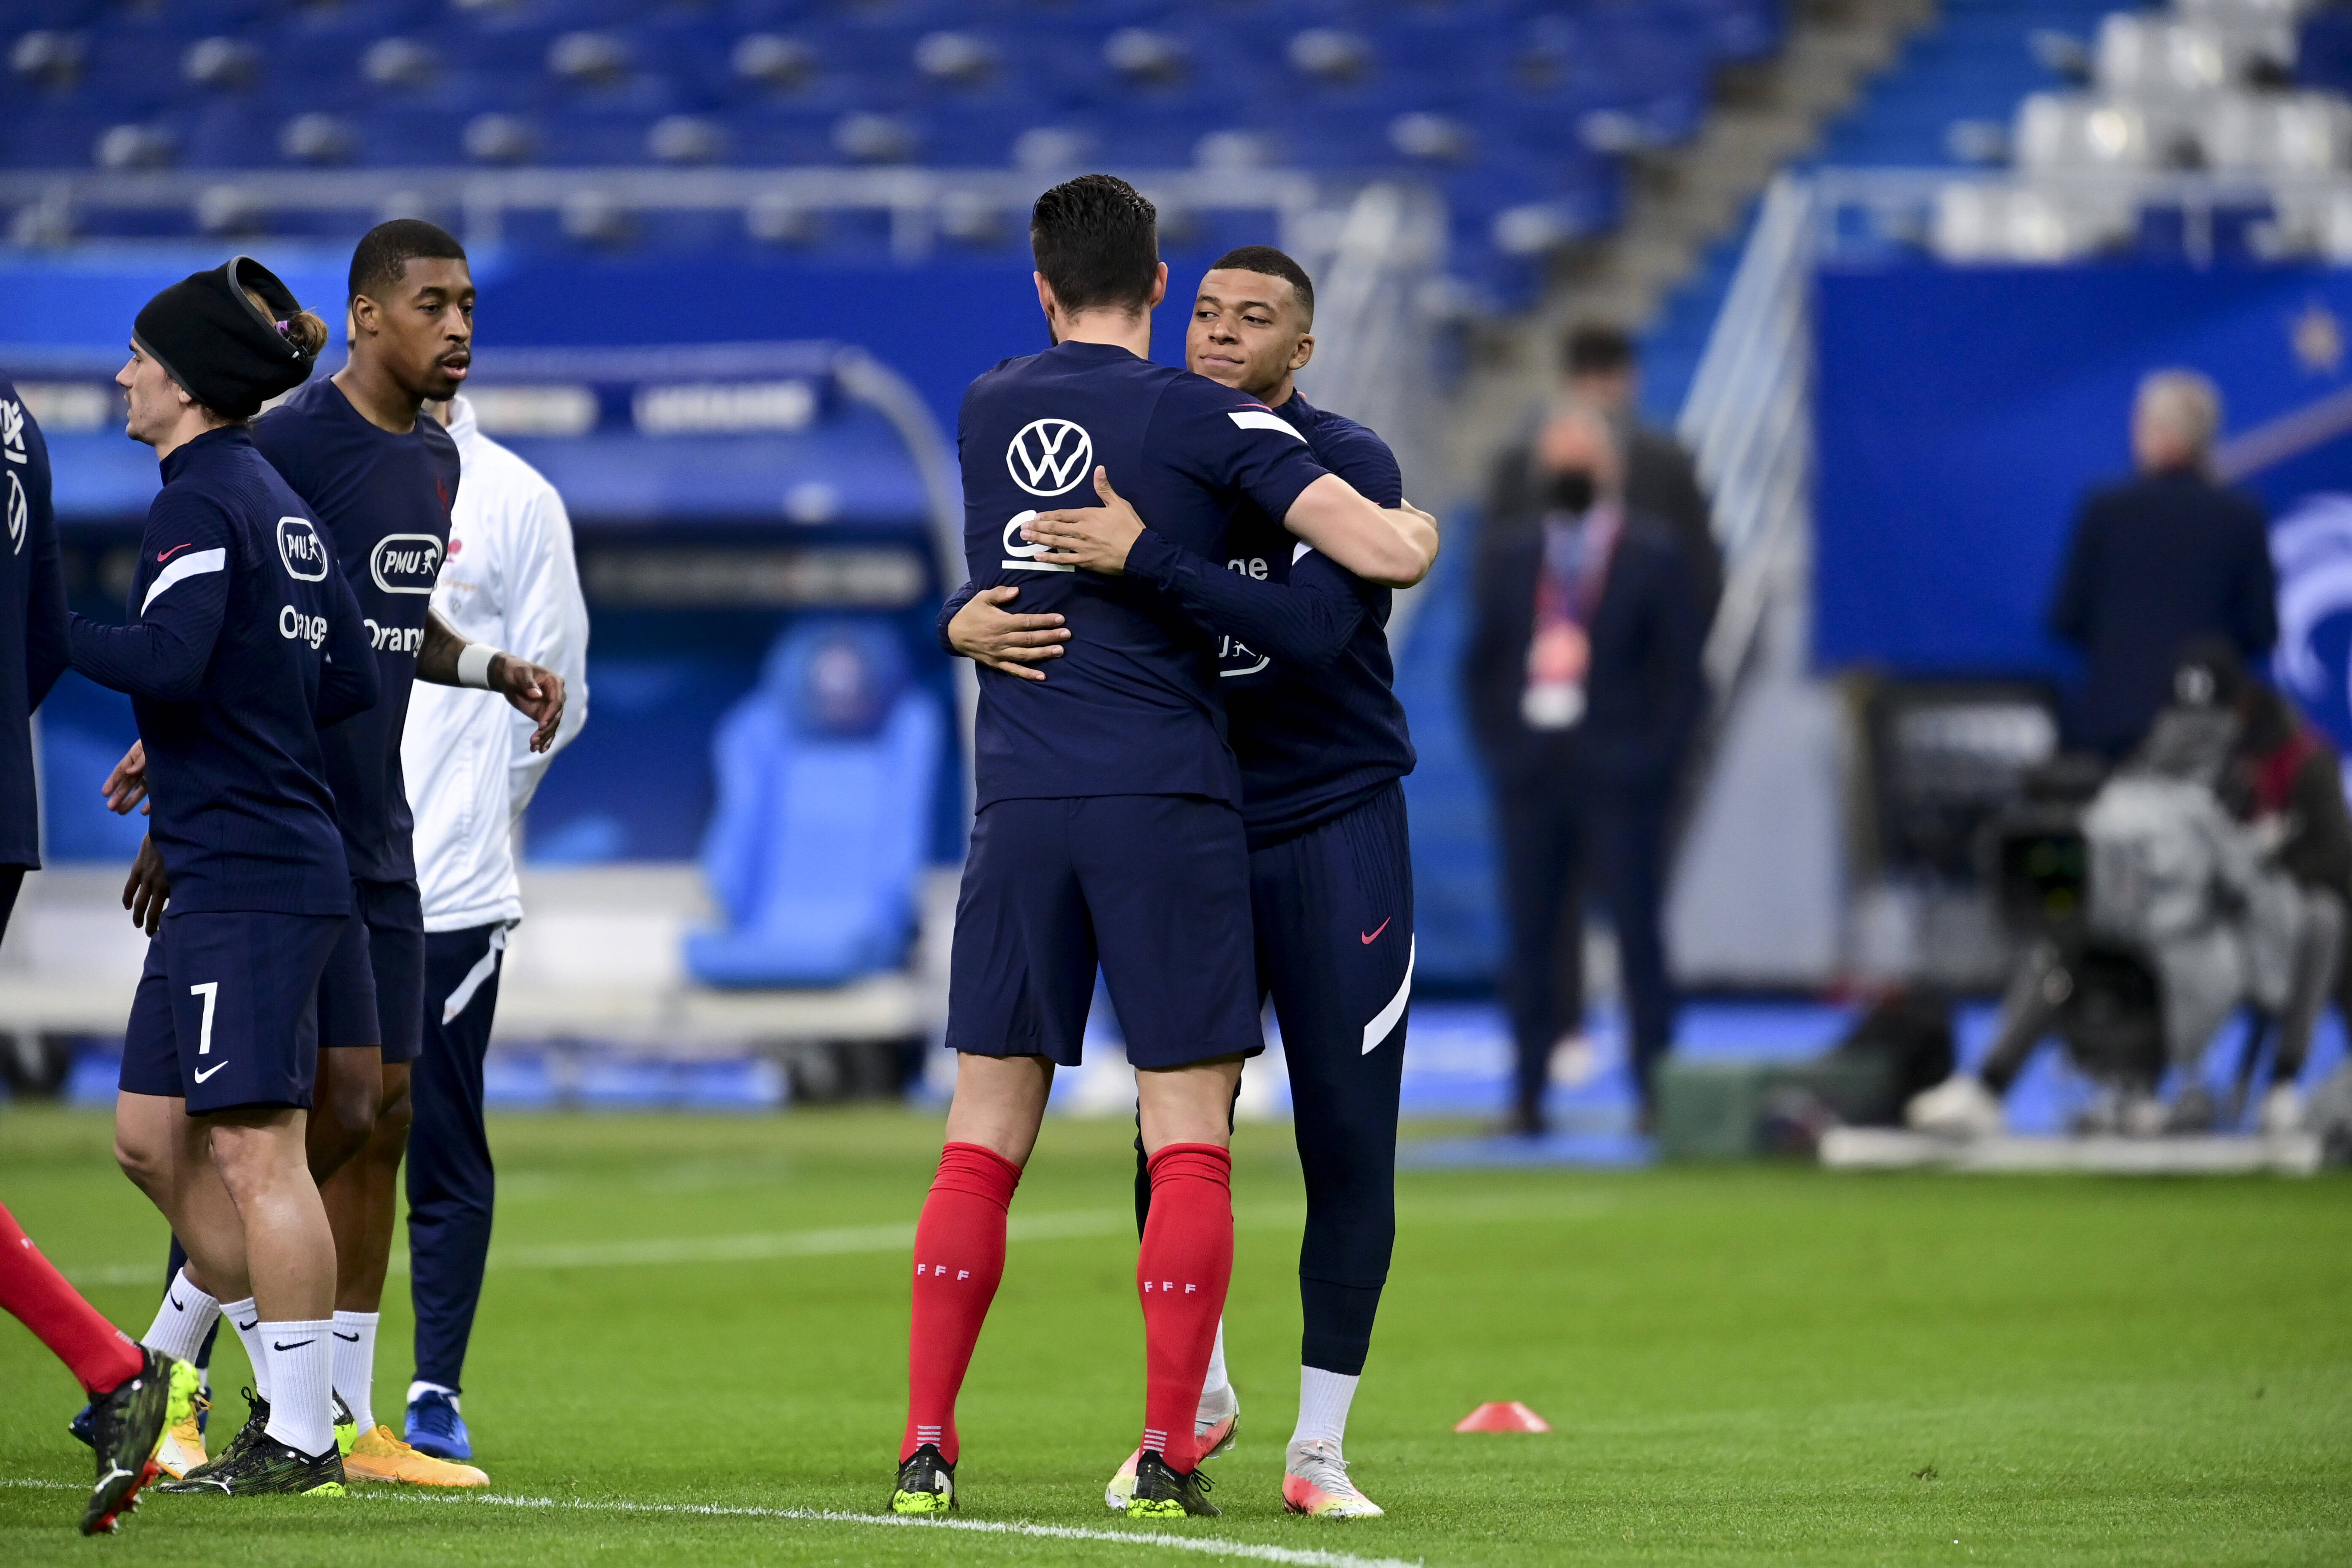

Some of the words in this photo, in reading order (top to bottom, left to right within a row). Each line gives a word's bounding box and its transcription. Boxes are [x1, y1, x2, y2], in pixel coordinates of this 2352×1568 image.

[286, 534, 307, 559] PMU
[383, 551, 421, 574] PMU
[279, 605, 327, 650] Orange
[190, 982, 218, 1055] 7
